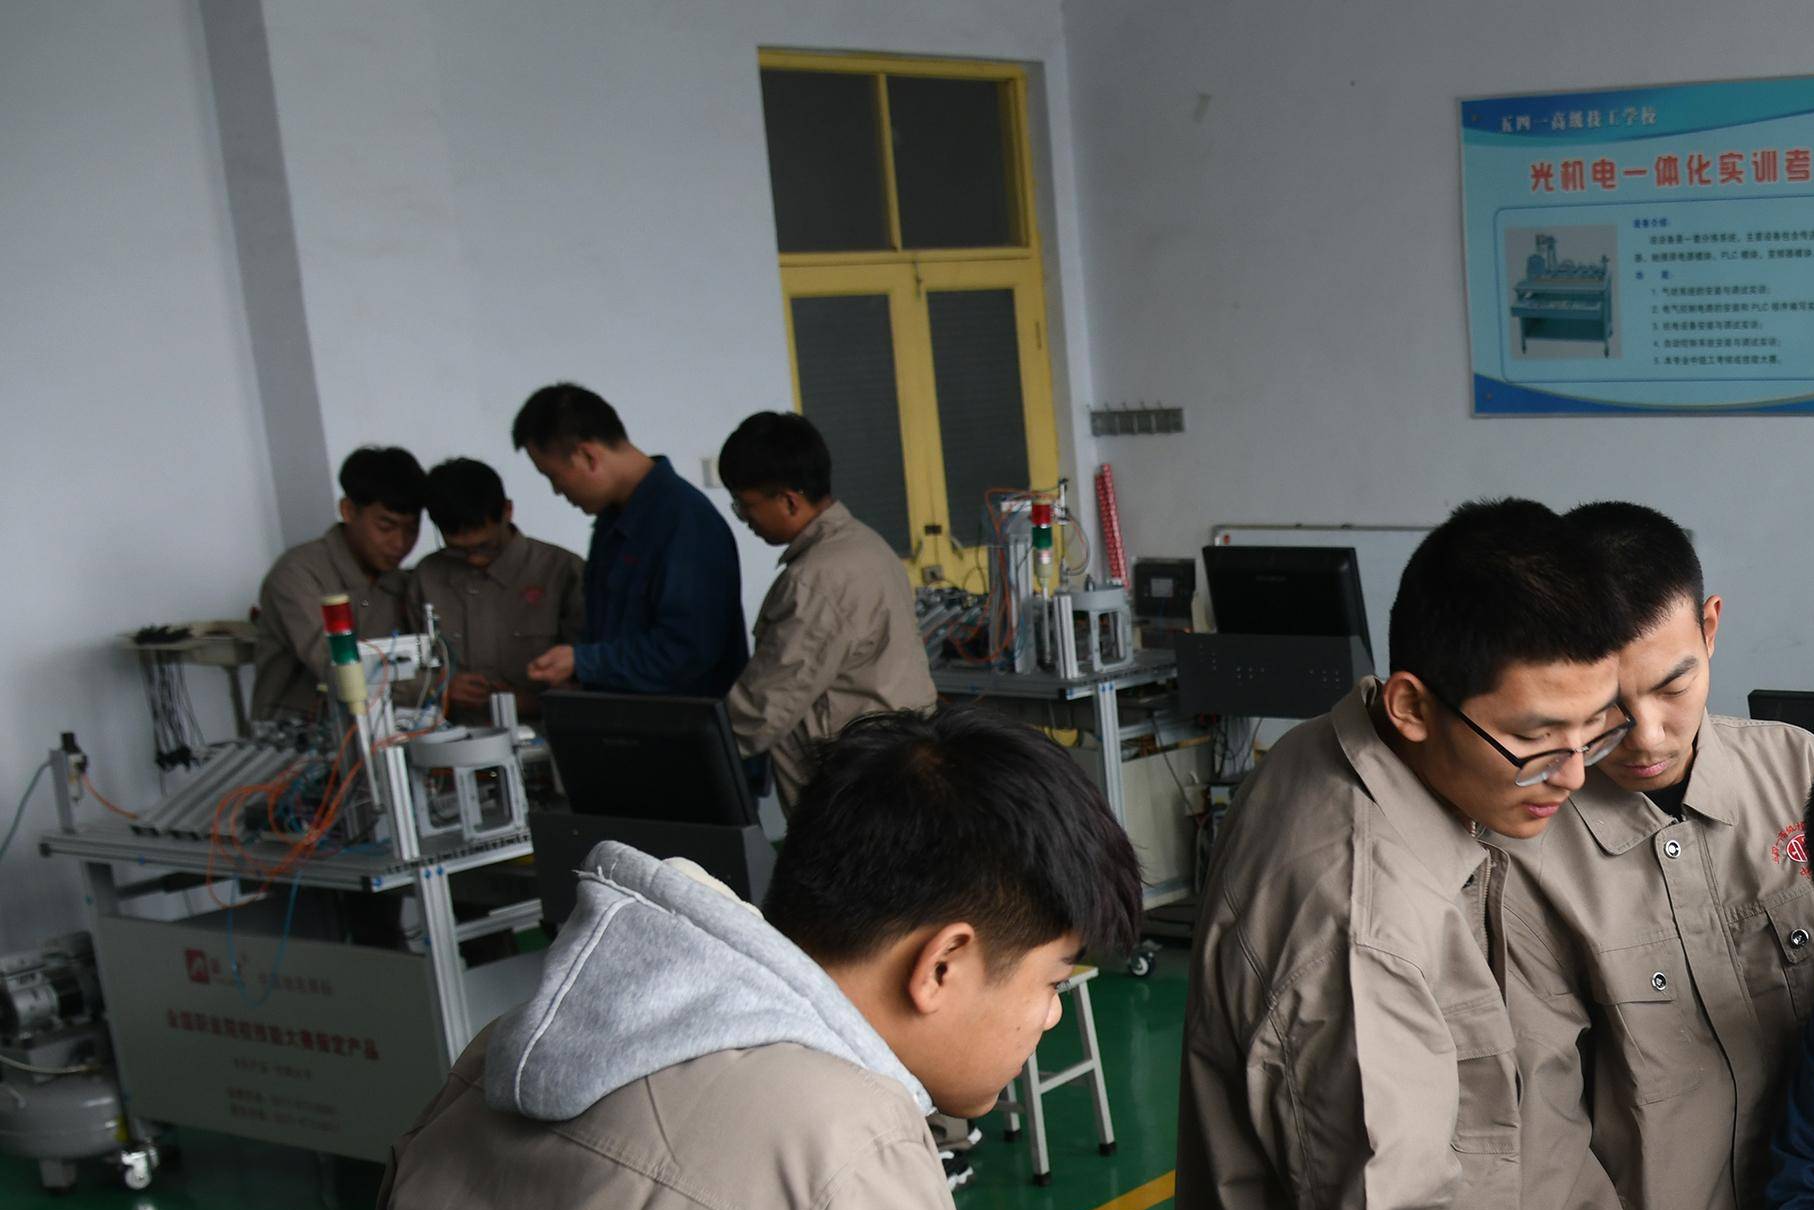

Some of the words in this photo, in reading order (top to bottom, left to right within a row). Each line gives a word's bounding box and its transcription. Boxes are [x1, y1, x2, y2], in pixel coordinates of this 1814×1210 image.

[1500, 104, 1659, 134] 五四一高级技工学校
